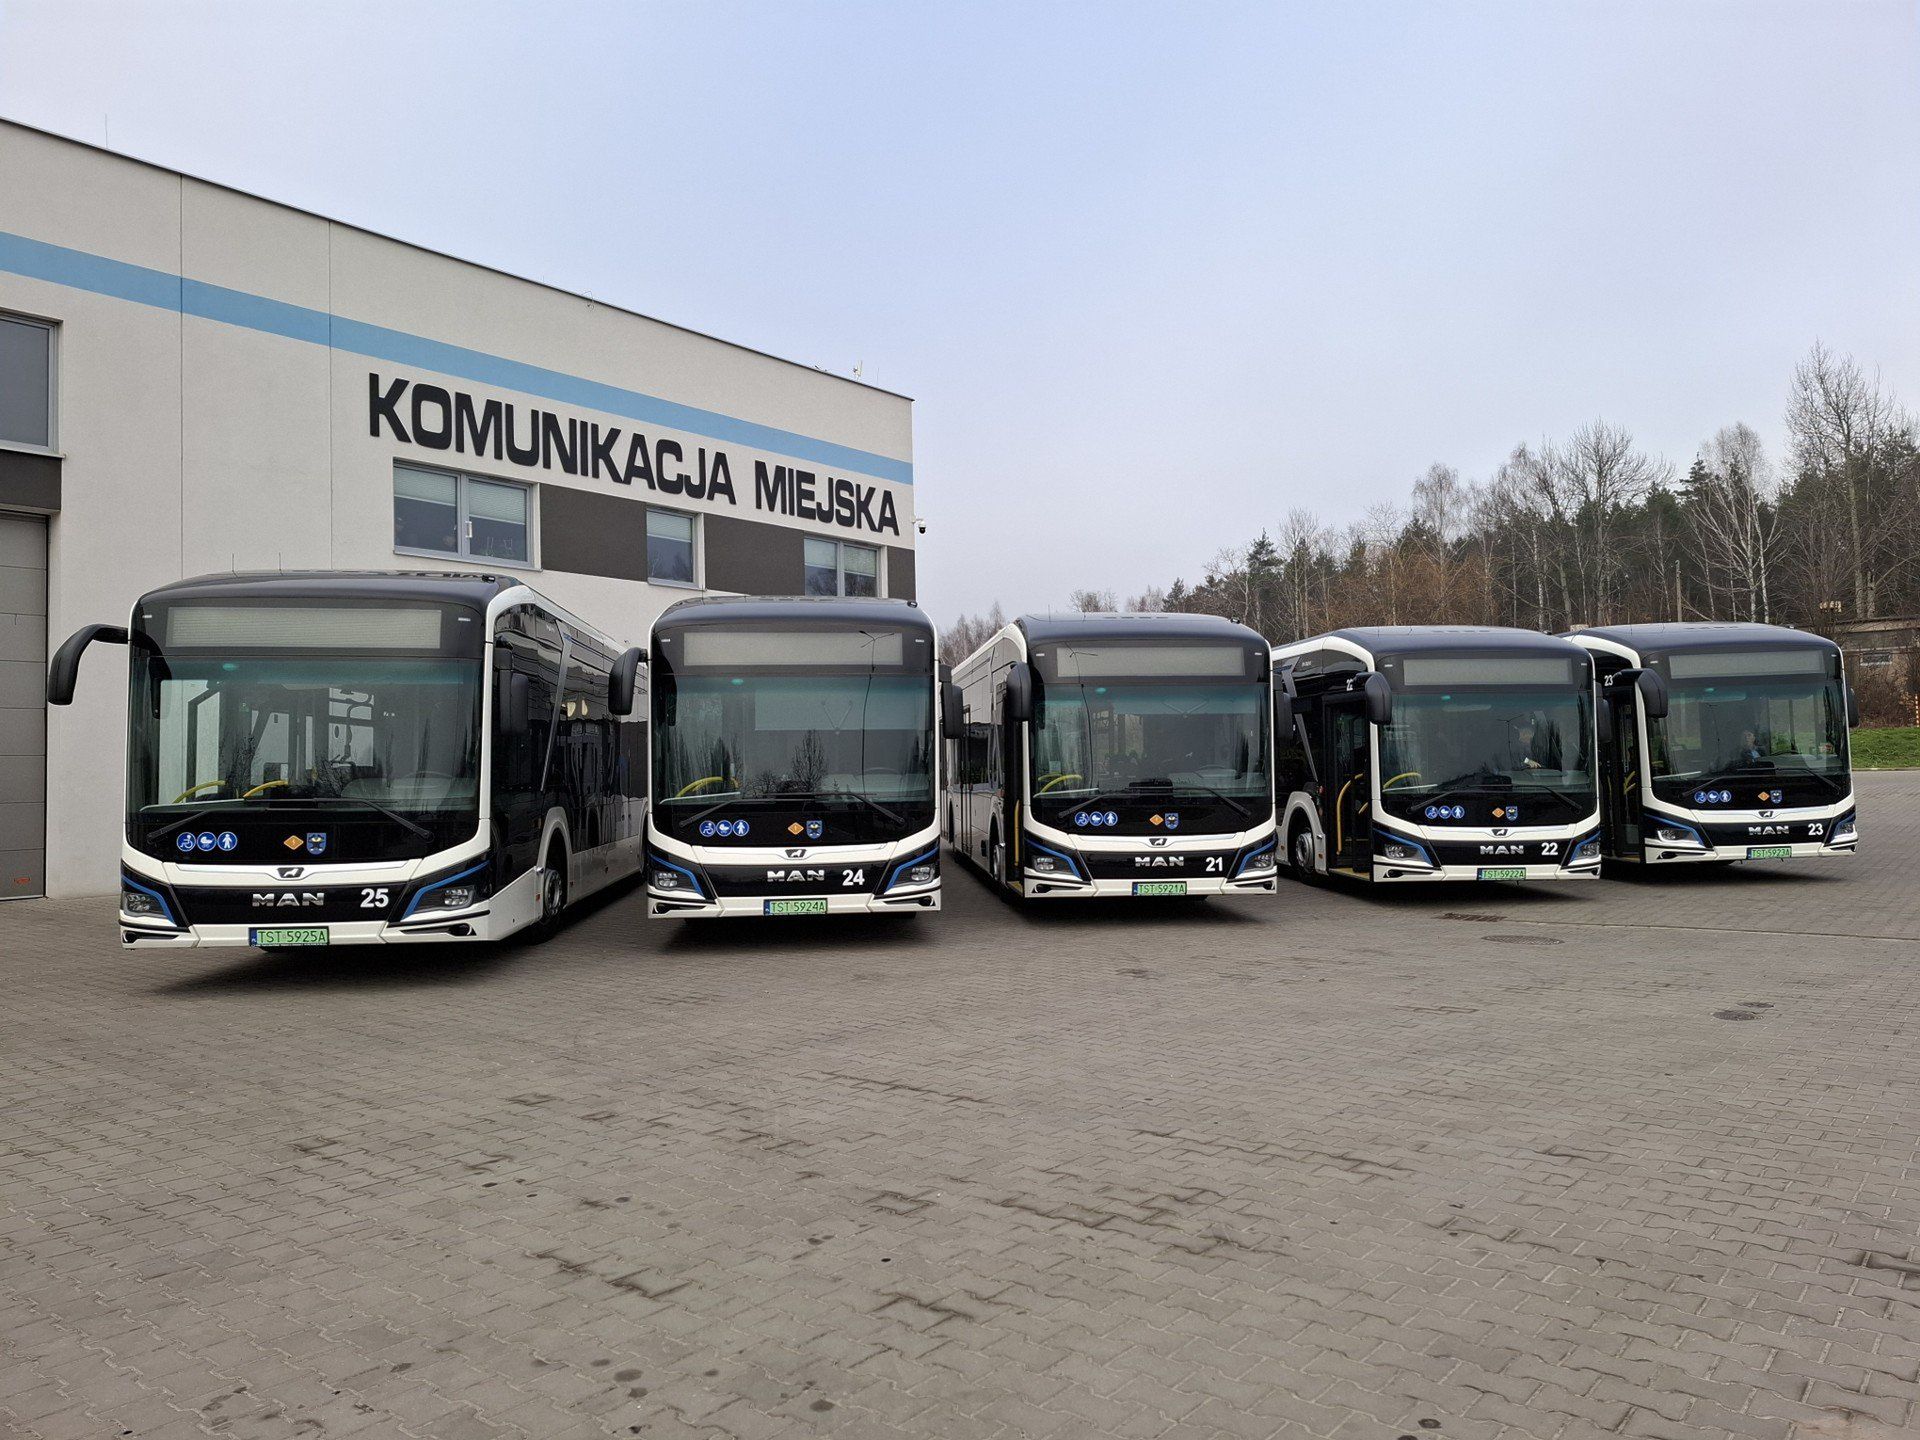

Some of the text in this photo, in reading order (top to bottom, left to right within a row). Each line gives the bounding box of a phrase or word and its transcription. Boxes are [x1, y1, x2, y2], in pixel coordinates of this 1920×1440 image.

[369, 372, 900, 536] KOMUNIKACJA MIEJSKA
[1604, 674, 1614, 686] 23
[1748, 825, 1789, 835] MAN
[1808, 823, 1823, 836] 23
[1480, 845, 1524, 855] MAN
[1541, 842, 1558, 856] 22
[1135, 856, 1184, 867] MAN
[1206, 857, 1223, 872] 21
[767, 870, 824, 882] MAN
[842, 869, 865, 886] 24
[1139, 884, 1184, 893] TST 5921A
[252, 893, 324, 906] MAN
[360, 888, 389, 908] 25
[771, 901, 825, 913] TST 5924A
[257, 930, 326, 943] TST 5925A
